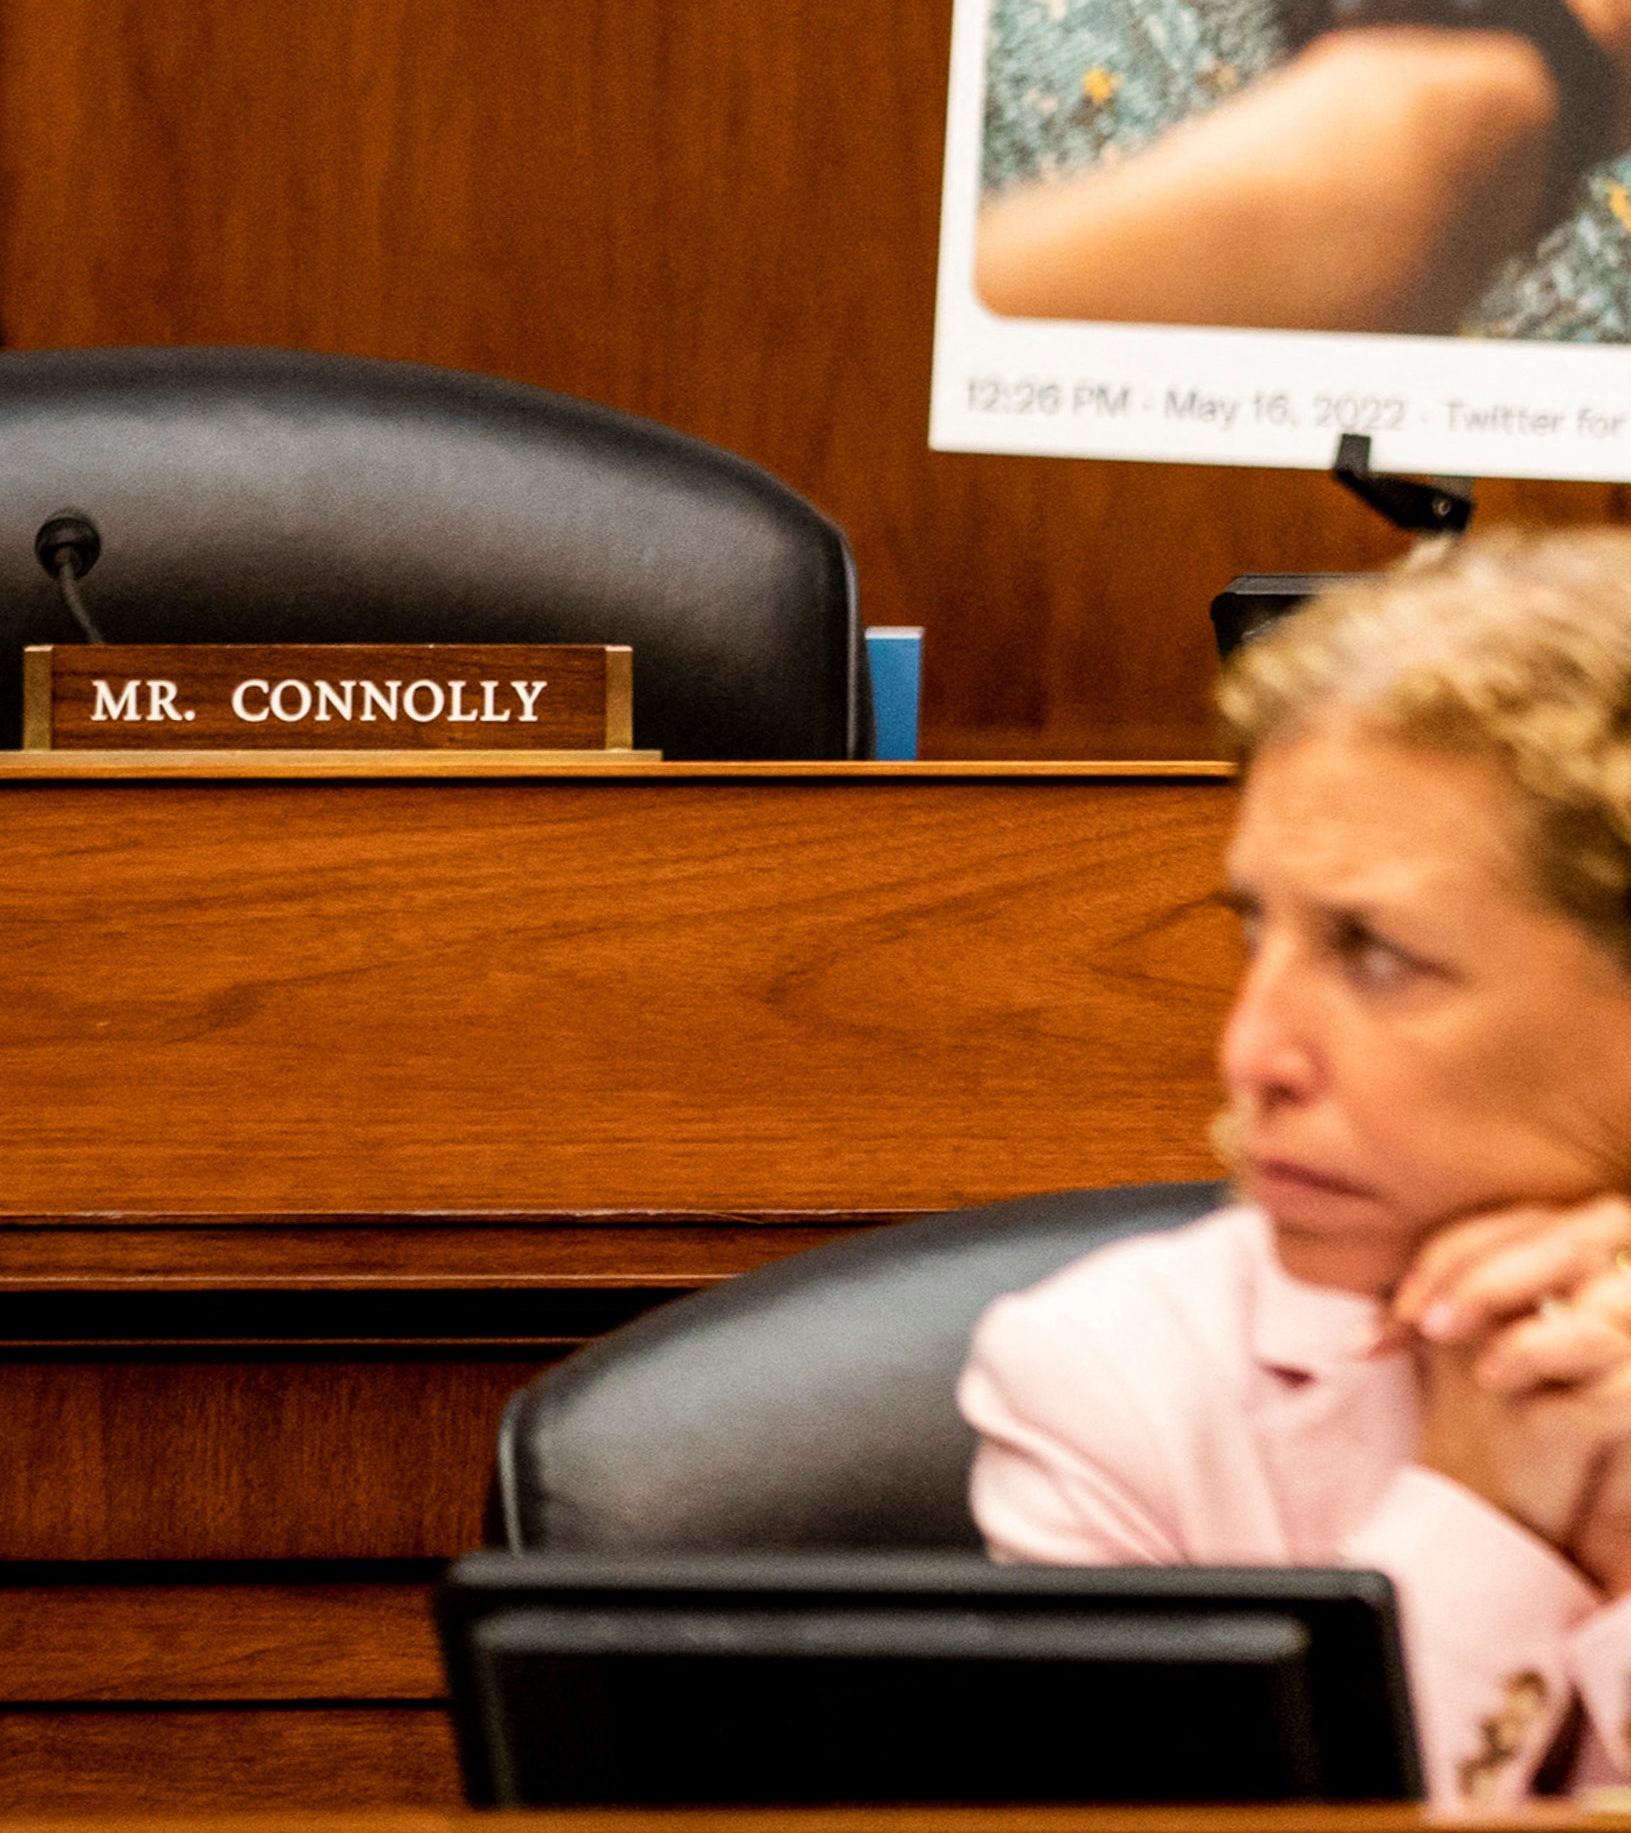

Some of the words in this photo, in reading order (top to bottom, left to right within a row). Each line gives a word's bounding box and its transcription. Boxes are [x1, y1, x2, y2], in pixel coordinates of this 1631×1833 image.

[966, 376, 1062, 416] 12:26
[1071, 381, 1131, 418] PM
[1163, 388, 1239, 430] May
[1313, 394, 1406, 432] 2022
[1445, 399, 1564, 438] Twitter
[1576, 407, 1625, 439] for
[90, 678, 197, 722] MR.
[230, 678, 548, 723] CONNOLLY
